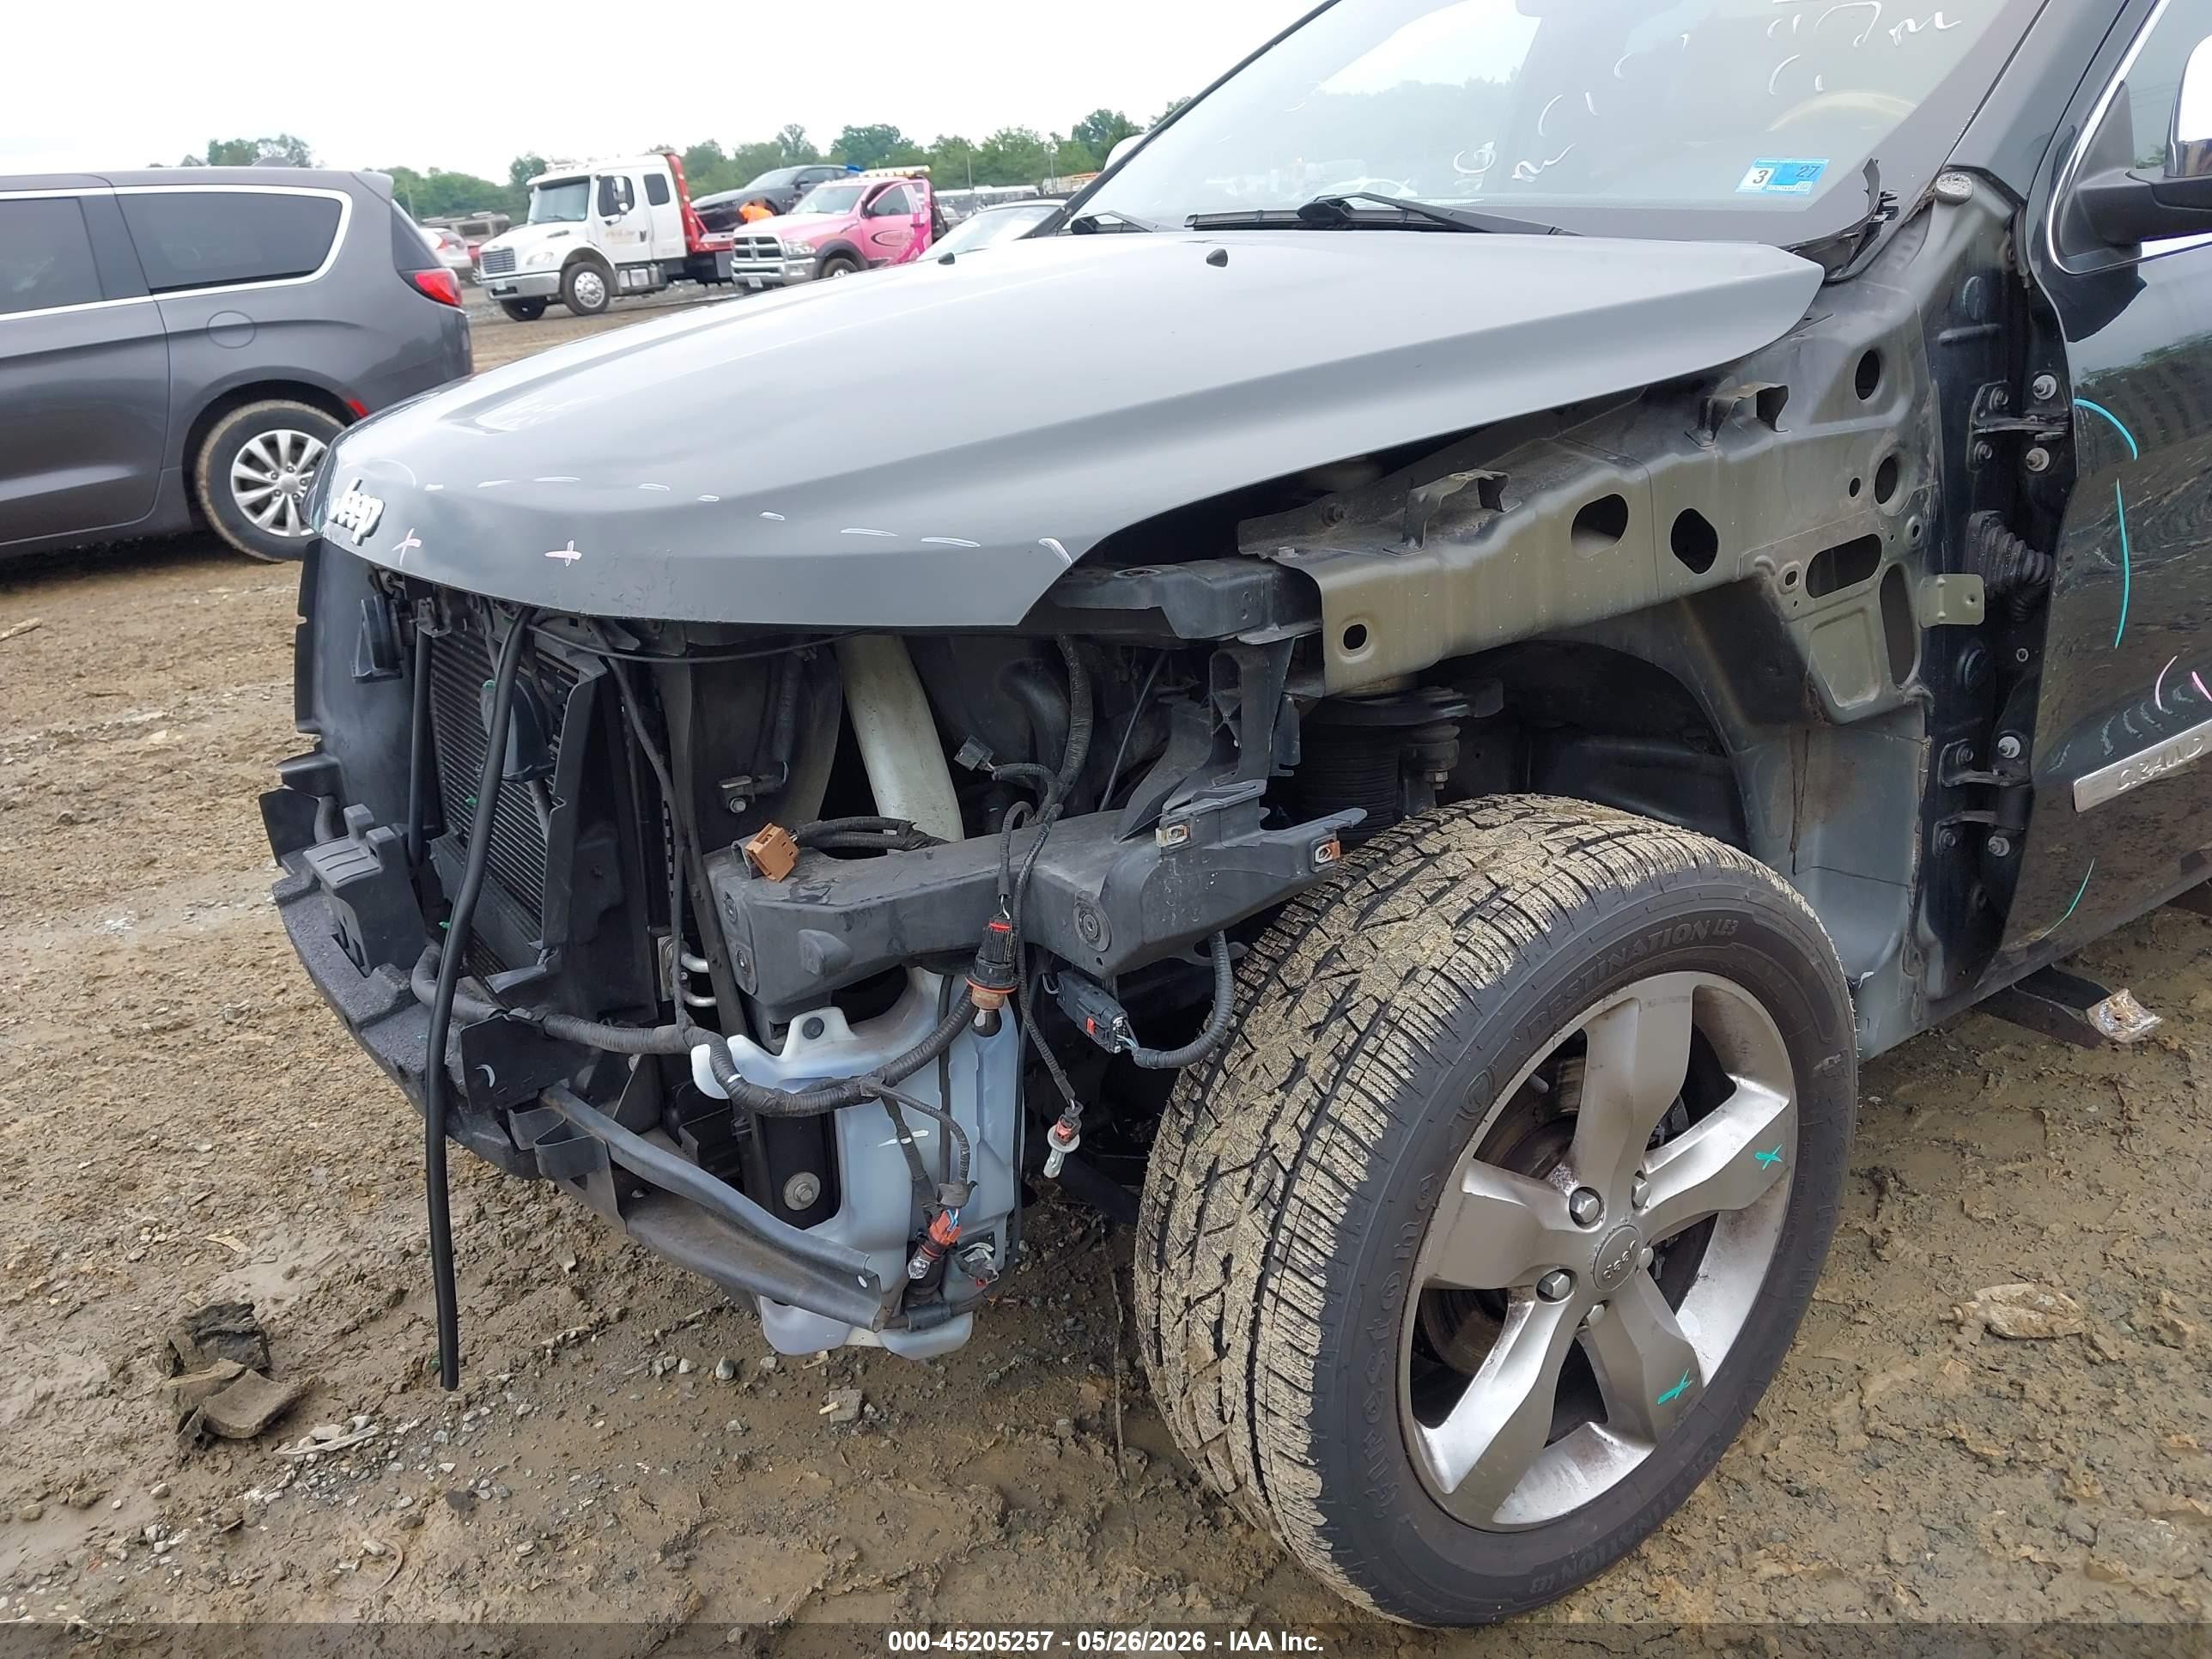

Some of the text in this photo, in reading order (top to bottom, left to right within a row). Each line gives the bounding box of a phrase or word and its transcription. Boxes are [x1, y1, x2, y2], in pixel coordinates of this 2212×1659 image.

[1753, 169, 1770, 185] 3
[1796, 164, 1821, 179] 27
[330, 477, 386, 546] Jeep
[1527, 918, 1740, 1038] DESTINATION LE3
[1364, 1171, 1439, 1517] Firestone
